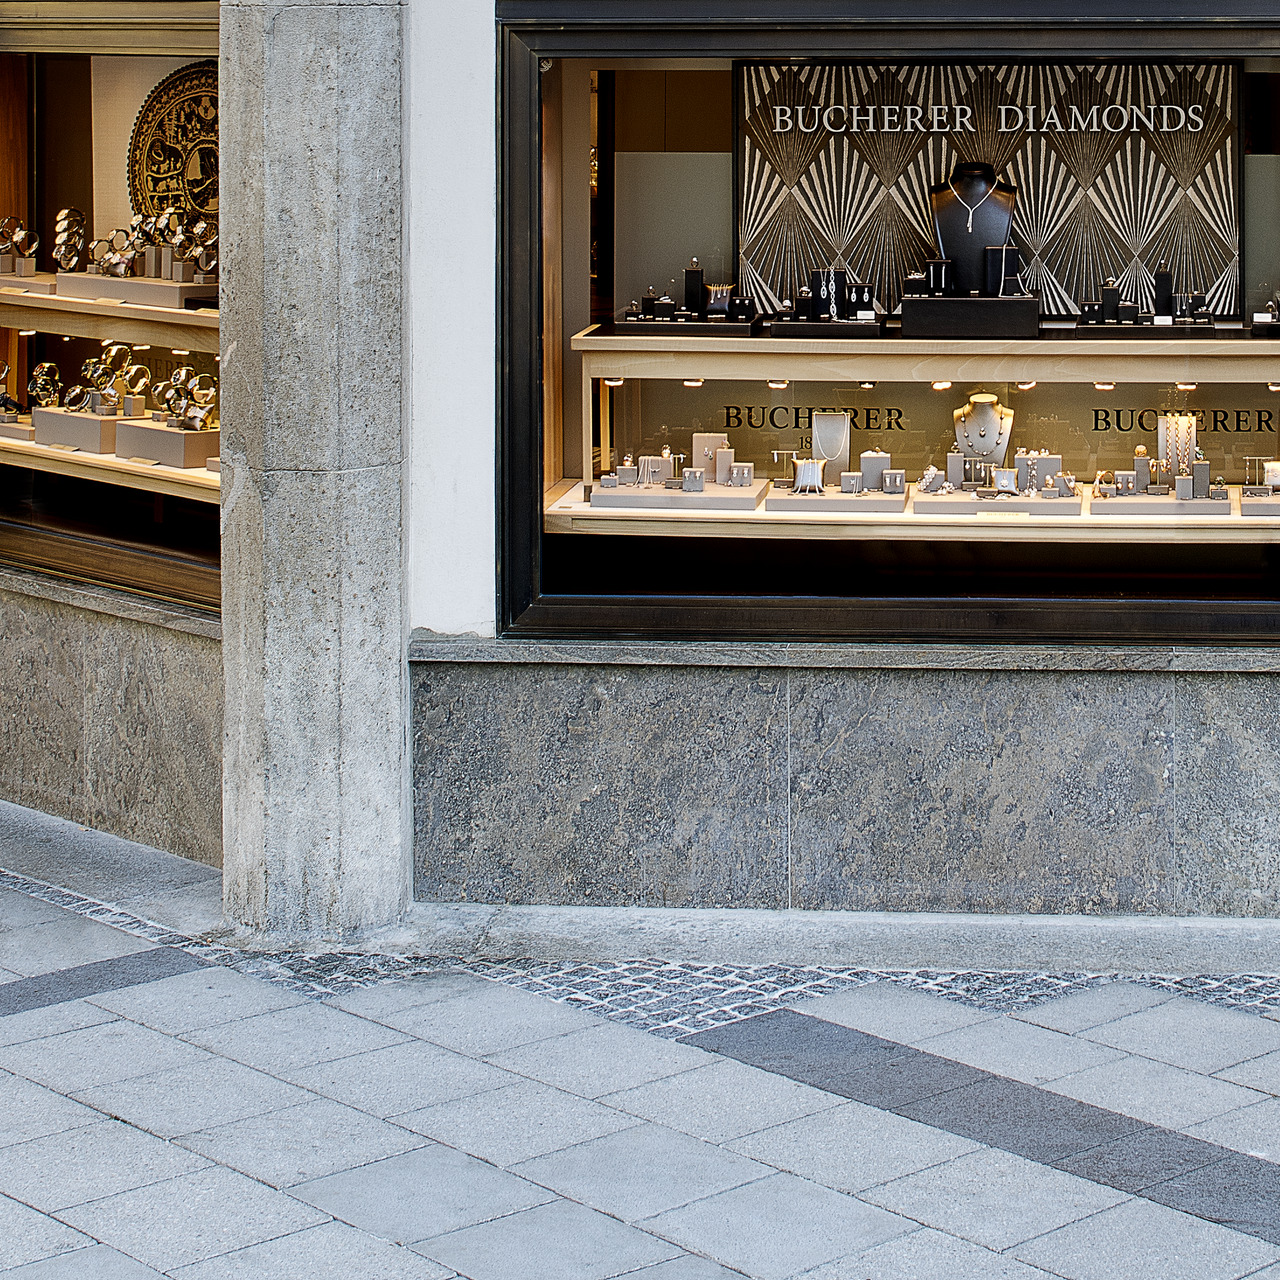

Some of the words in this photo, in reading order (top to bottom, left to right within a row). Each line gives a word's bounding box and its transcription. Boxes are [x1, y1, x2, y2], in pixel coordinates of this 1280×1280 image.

[772, 104, 976, 133] BUCHERER
[997, 104, 1204, 133] DIAMONDS
[723, 405, 906, 430] BUCHRER
[1092, 409, 1277, 433] BUCERER
